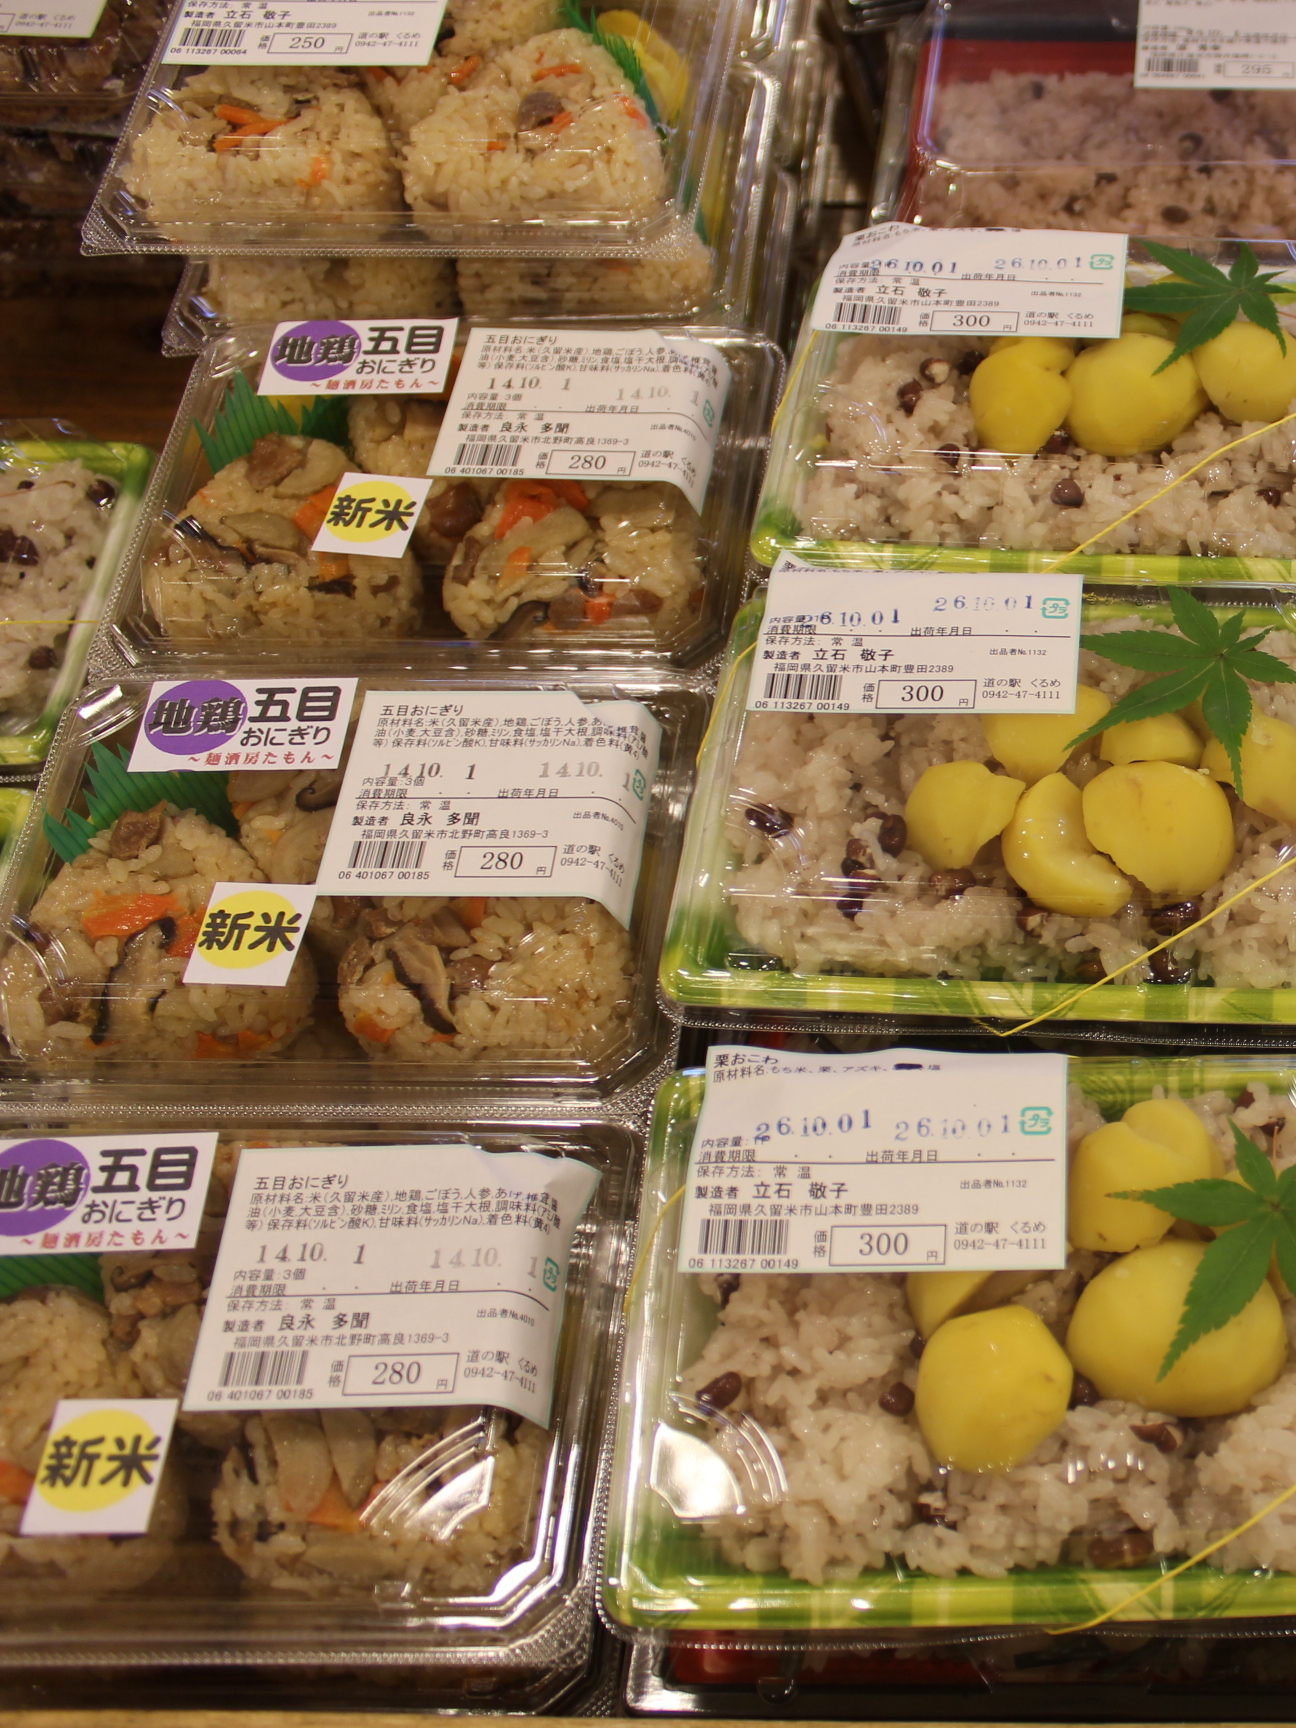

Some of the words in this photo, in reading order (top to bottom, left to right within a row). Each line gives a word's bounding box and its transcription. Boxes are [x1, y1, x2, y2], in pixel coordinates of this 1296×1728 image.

[224, 10, 251, 19] 立石
[289, 37, 325, 49] 250
[1241, 64, 1272, 74] 295
[876, 285, 905, 295] 立石
[917, 287, 947, 298] 敬子
[953, 315, 990, 327] 300
[362, 326, 444, 354] 五目
[484, 334, 558, 344] 五目おにぎり
[356, 358, 436, 374] おにぎり
[500, 422, 528, 432] 良永
[540, 423, 569, 434] 多聞
[568, 455, 606, 470] 280
[327, 496, 418, 532] 新米
[763, 650, 800, 660] 製造者
[813, 648, 846, 661] 立石
[860, 648, 894, 661] 敬子
[774, 662, 954, 673] 福岡県久留米市山本町豊田2389
[983, 678, 1021, 688] 道の駅
[1031, 678, 1061, 687] くるめ
[901, 685, 944, 702] 300
[982, 690, 1060, 699] 0942-47-4111
[148, 697, 245, 736] 地鶏
[248, 686, 341, 722] 五目
[380, 704, 464, 716] 五目おにぎり
[755, 701, 768, 709] 06
[773, 701, 812, 710] 113267
[816, 702, 849, 710] 00149
[240, 726, 331, 746] おにぎり
[352, 815, 388, 826] 製造者
[400, 813, 433, 826] 良永
[447, 813, 479, 826] 多聞
[563, 844, 601, 856] 道の駅
[480, 851, 524, 871] 280
[339, 871, 351, 879] 06
[356, 870, 394, 879] 401067
[398, 871, 429, 880] 00185
[198, 909, 303, 954] 新米
[714, 1054, 779, 1068] 栗おこわ
[865, 1150, 938, 1162] 出荷年月日
[91, 1146, 198, 1193] 五目
[255, 1175, 349, 1190] 五目おにぎり
[695, 1186, 739, 1199] 製造者
[753, 1182, 792, 1199] 立石
[808, 1182, 848, 1199] 敬子
[82, 1197, 186, 1223] おにぎり
[708, 1203, 919, 1216] 福岡県久留米市山本町豊田2389
[954, 1221, 999, 1234] 道の駅
[1010, 1221, 1045, 1233] くるめ
[858, 1233, 909, 1255] 300
[954, 1238, 1045, 1250] 0942-47-4111
[710, 1259, 755, 1269] 113267
[760, 1258, 798, 1268] 00149
[223, 1319, 264, 1332] 製造者
[278, 1314, 316, 1331] 良永
[332, 1312, 369, 1329] 多聞
[466, 1350, 510, 1364] 道の駅
[372, 1362, 422, 1385] 280
[227, 1389, 271, 1400] 401067
[277, 1388, 312, 1400] 00185
[41, 1435, 162, 1487] 新米
